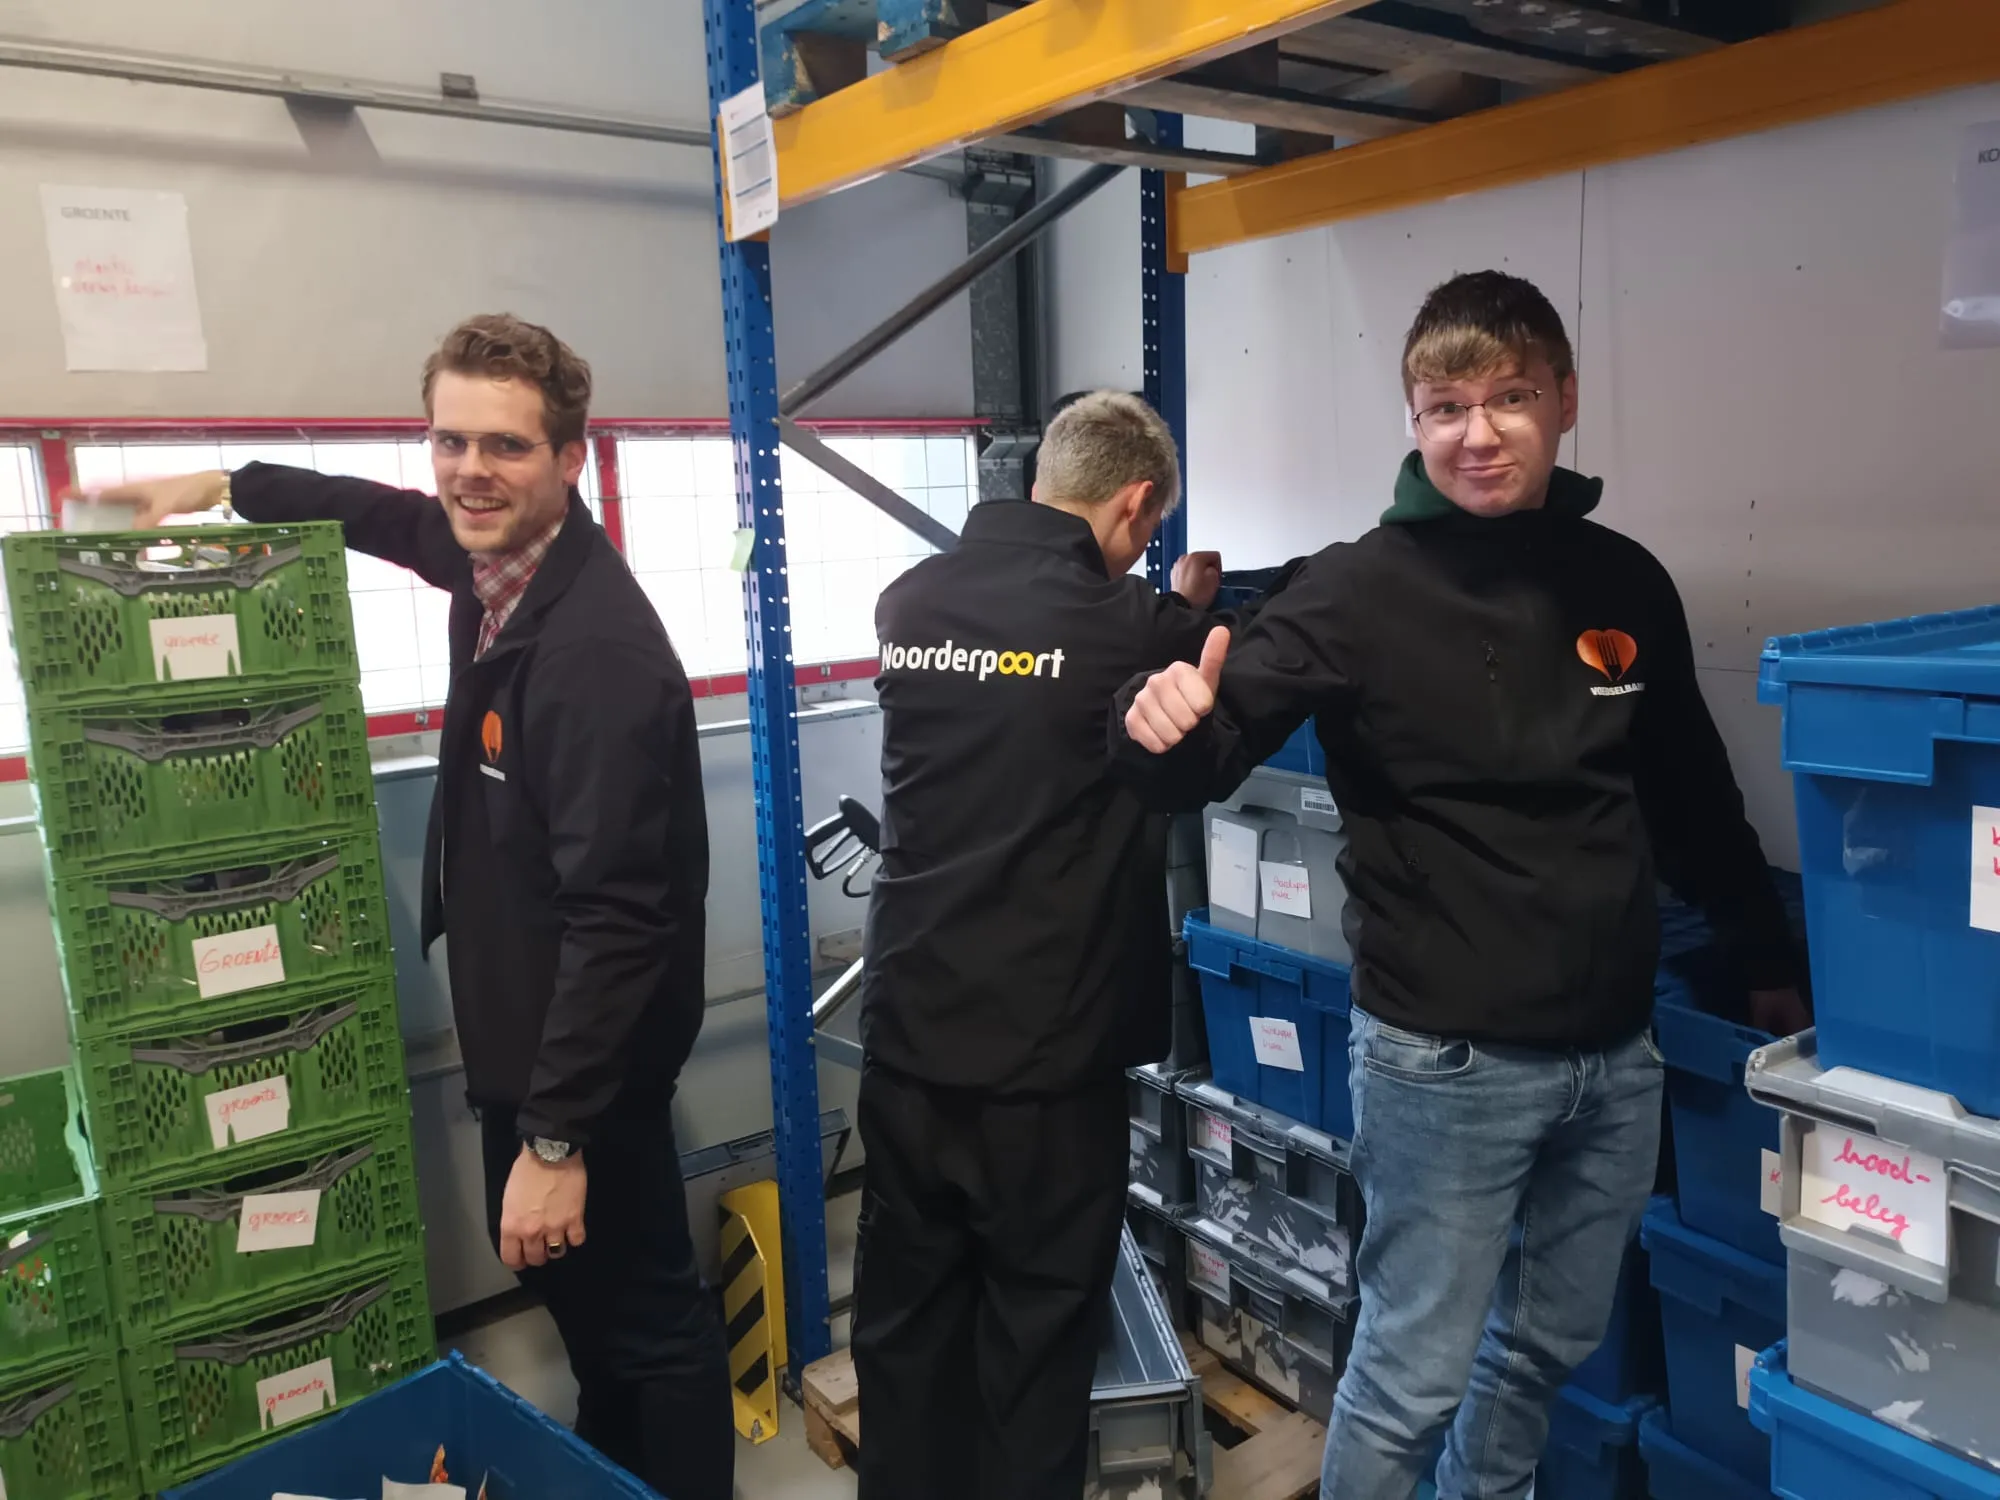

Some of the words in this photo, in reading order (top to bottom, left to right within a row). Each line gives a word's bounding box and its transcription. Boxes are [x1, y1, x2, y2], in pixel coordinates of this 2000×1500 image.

[60, 206, 131, 222] GROENTE
[881, 639, 1065, 682] Noorderpoort
[1820, 1183, 1911, 1240] beleg
